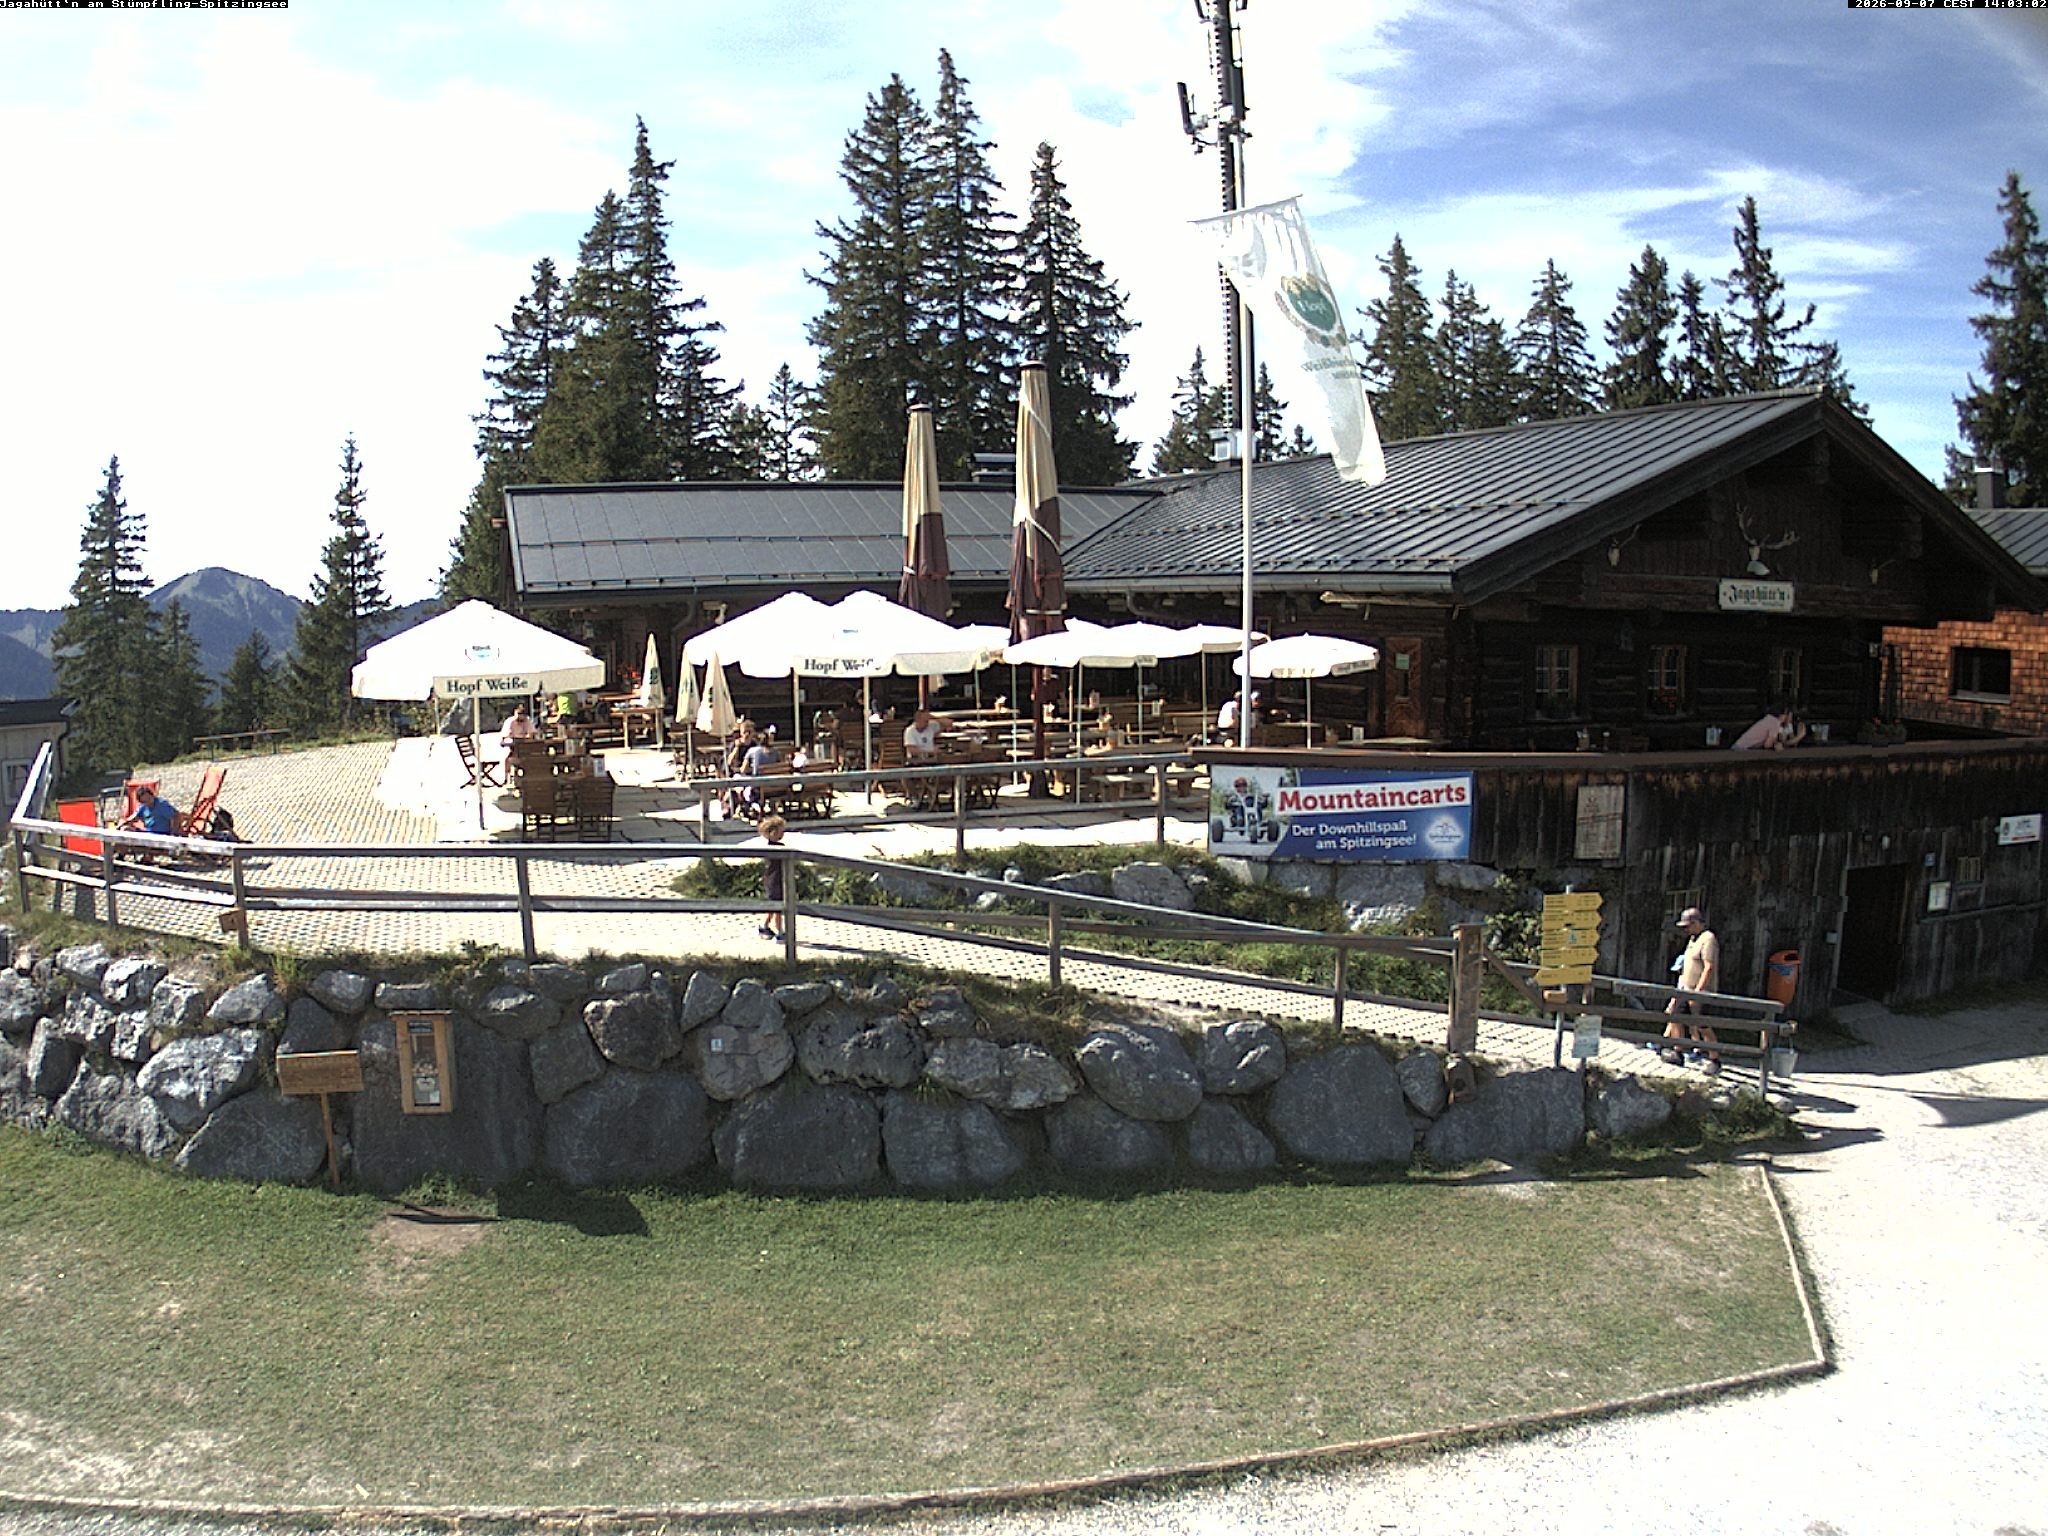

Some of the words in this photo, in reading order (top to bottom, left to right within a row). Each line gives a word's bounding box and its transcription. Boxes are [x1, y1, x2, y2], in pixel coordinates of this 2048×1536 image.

[804, 659, 839, 674] Hopf
[446, 678, 482, 694] Hopf
[485, 676, 528, 690] Weiße
[1279, 784, 1465, 811] Mountaincarts
[1292, 823, 1315, 836] Der
[1319, 820, 1407, 837] Downhillspaß
[1316, 839, 1336, 850] am
[1340, 834, 1417, 850] Spitzingsee!
